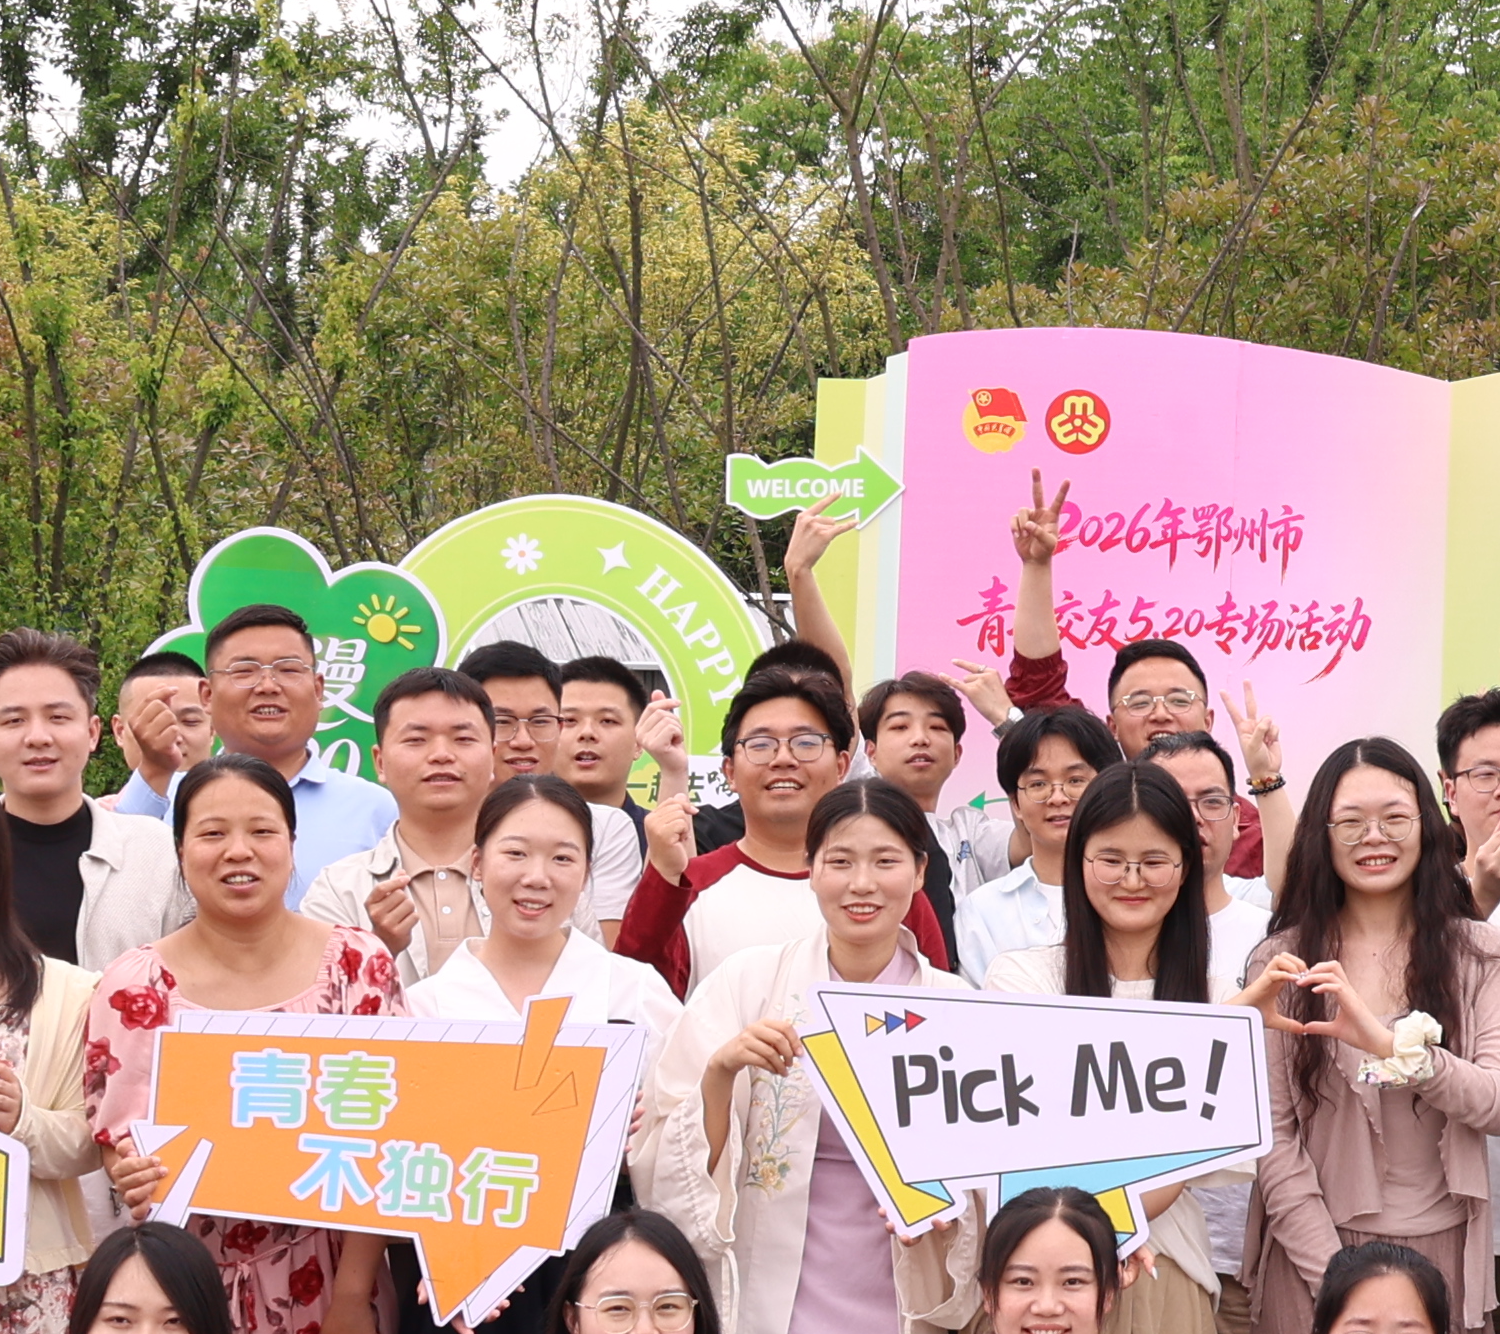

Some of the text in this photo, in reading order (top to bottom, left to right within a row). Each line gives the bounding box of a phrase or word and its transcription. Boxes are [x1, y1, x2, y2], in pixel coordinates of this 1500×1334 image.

[746, 478, 865, 498] WELCOME
[634, 563, 743, 707] HAPPY
[956, 575, 1373, 685] 青交友5.20专场活动
[234, 1051, 394, 1127] 青春
[892, 1039, 1228, 1128] Pick Me!
[295, 1135, 538, 1226] 不独行
